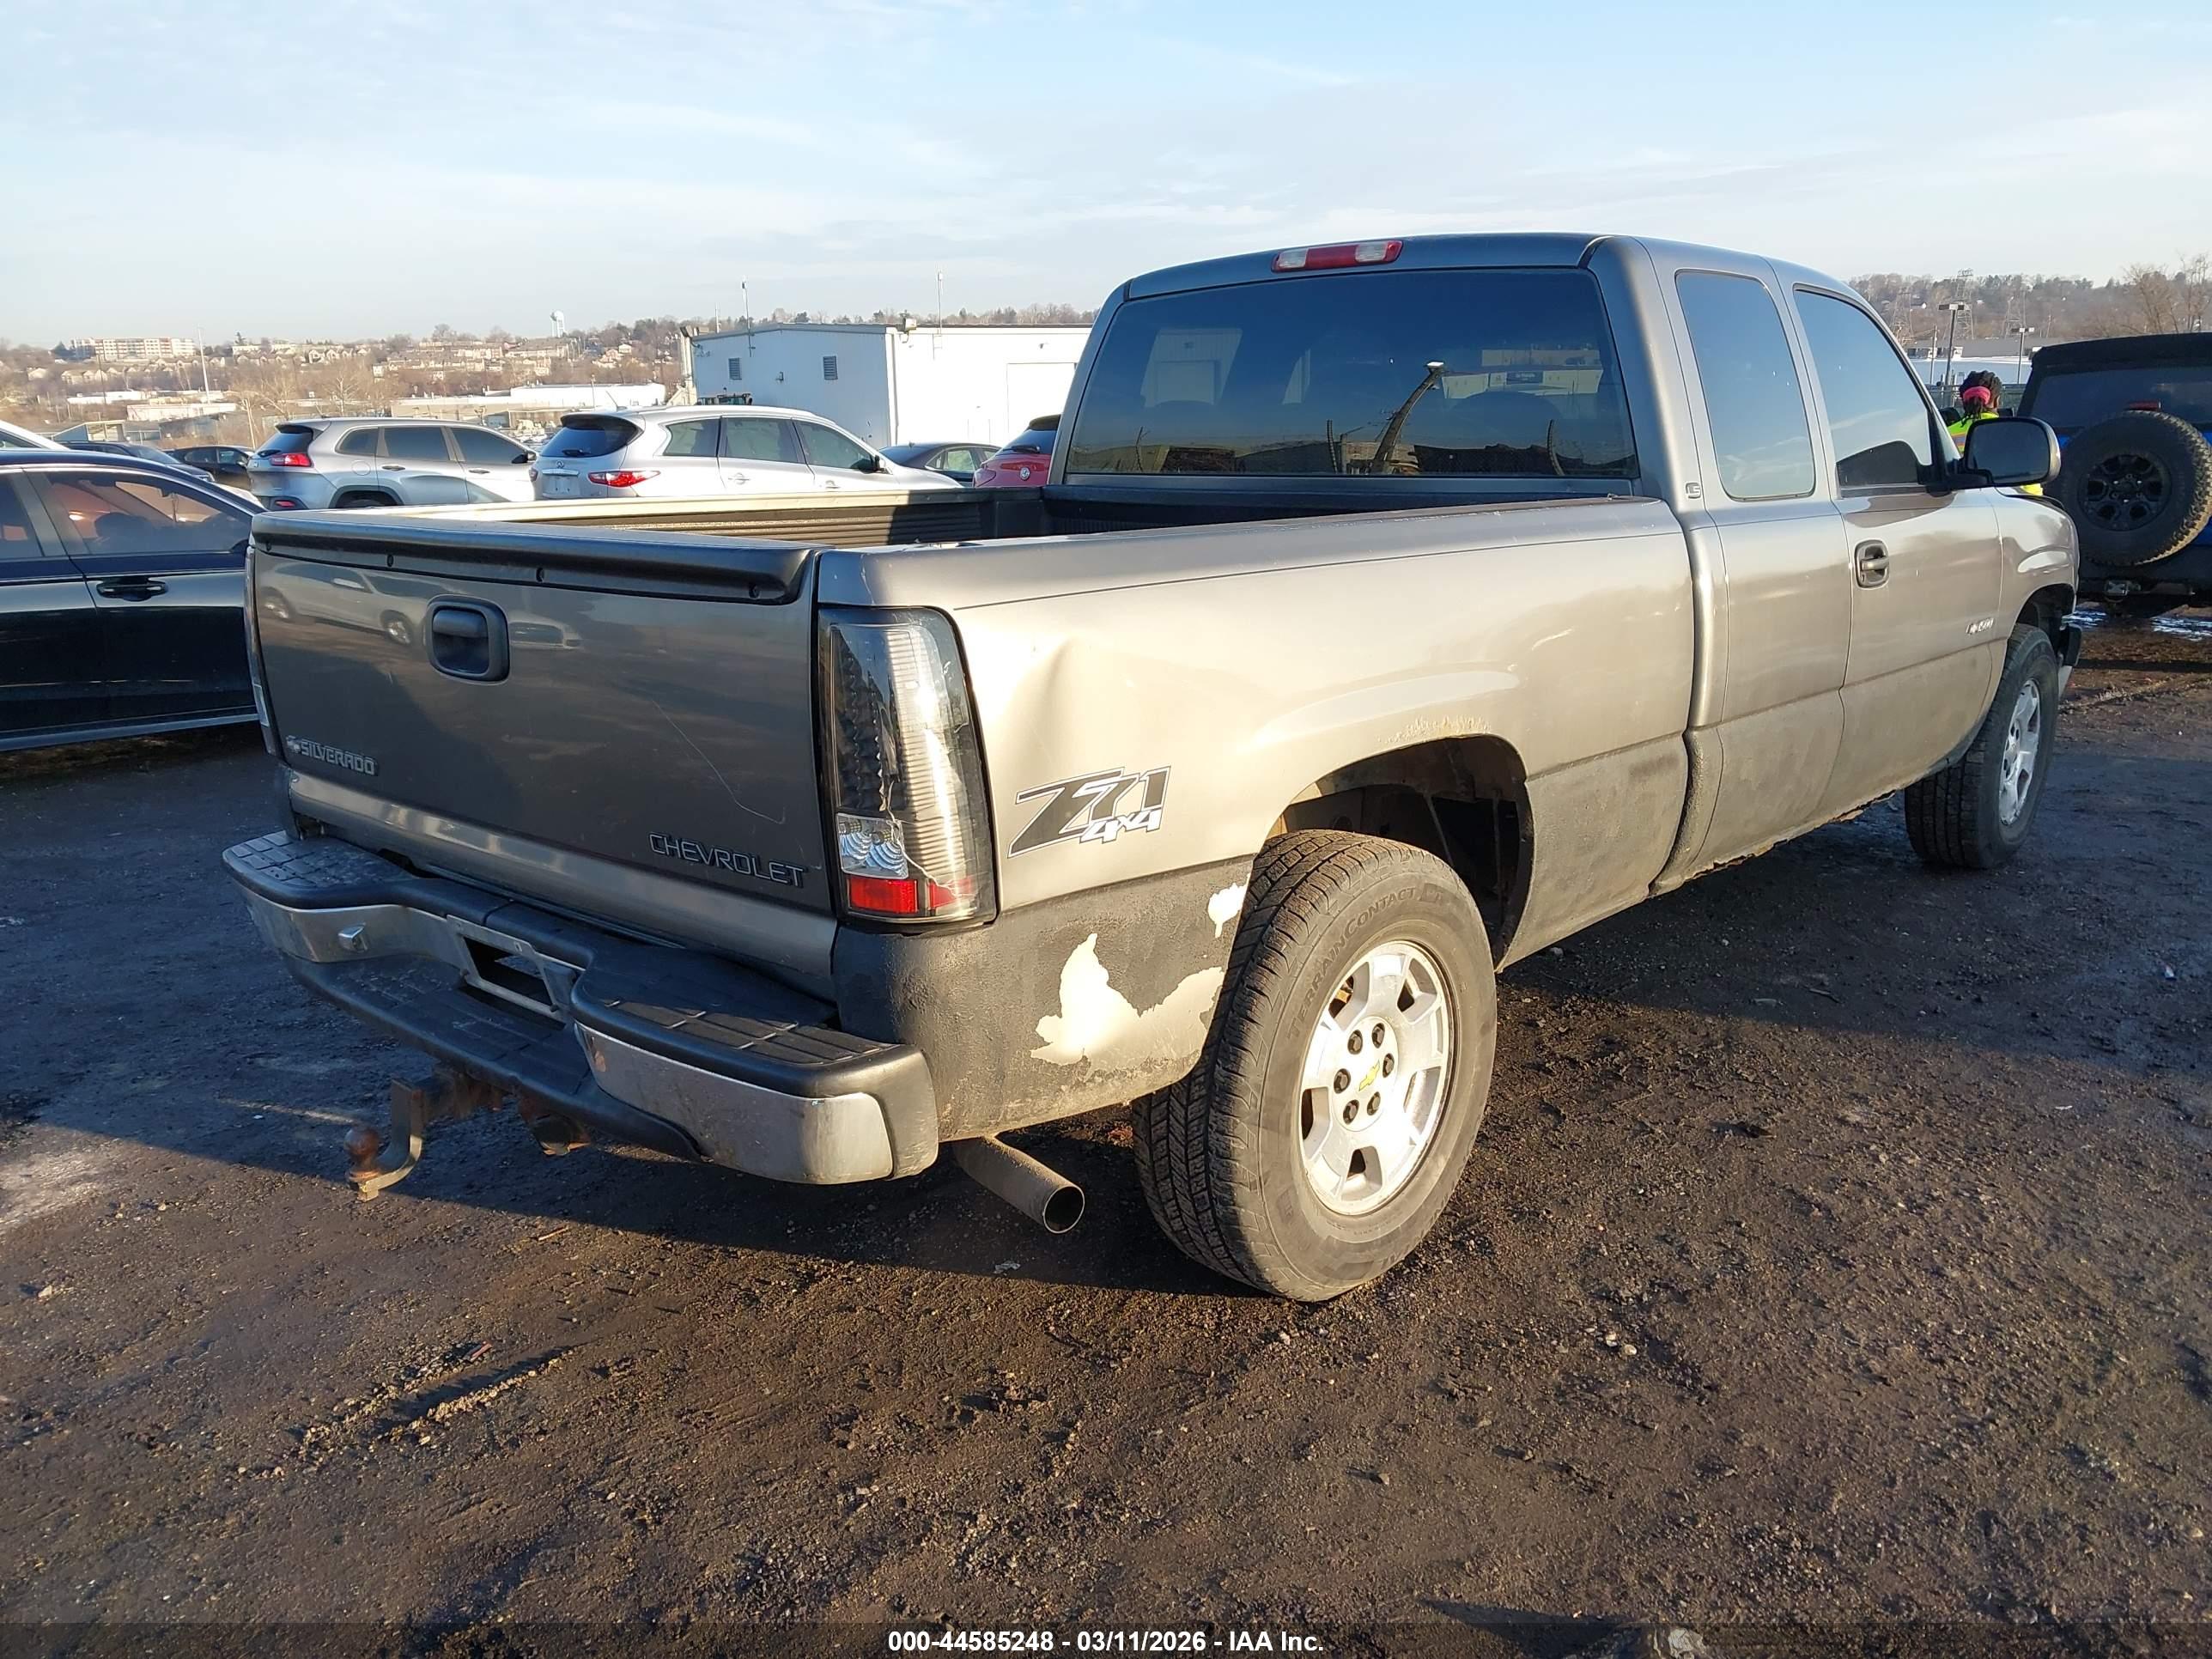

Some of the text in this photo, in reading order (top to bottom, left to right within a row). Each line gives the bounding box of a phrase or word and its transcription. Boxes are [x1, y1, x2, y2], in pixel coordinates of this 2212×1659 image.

[301, 738, 378, 776] SILVERADO
[1007, 766, 1171, 859] Z71
[649, 833, 805, 888] CHEVROLET
